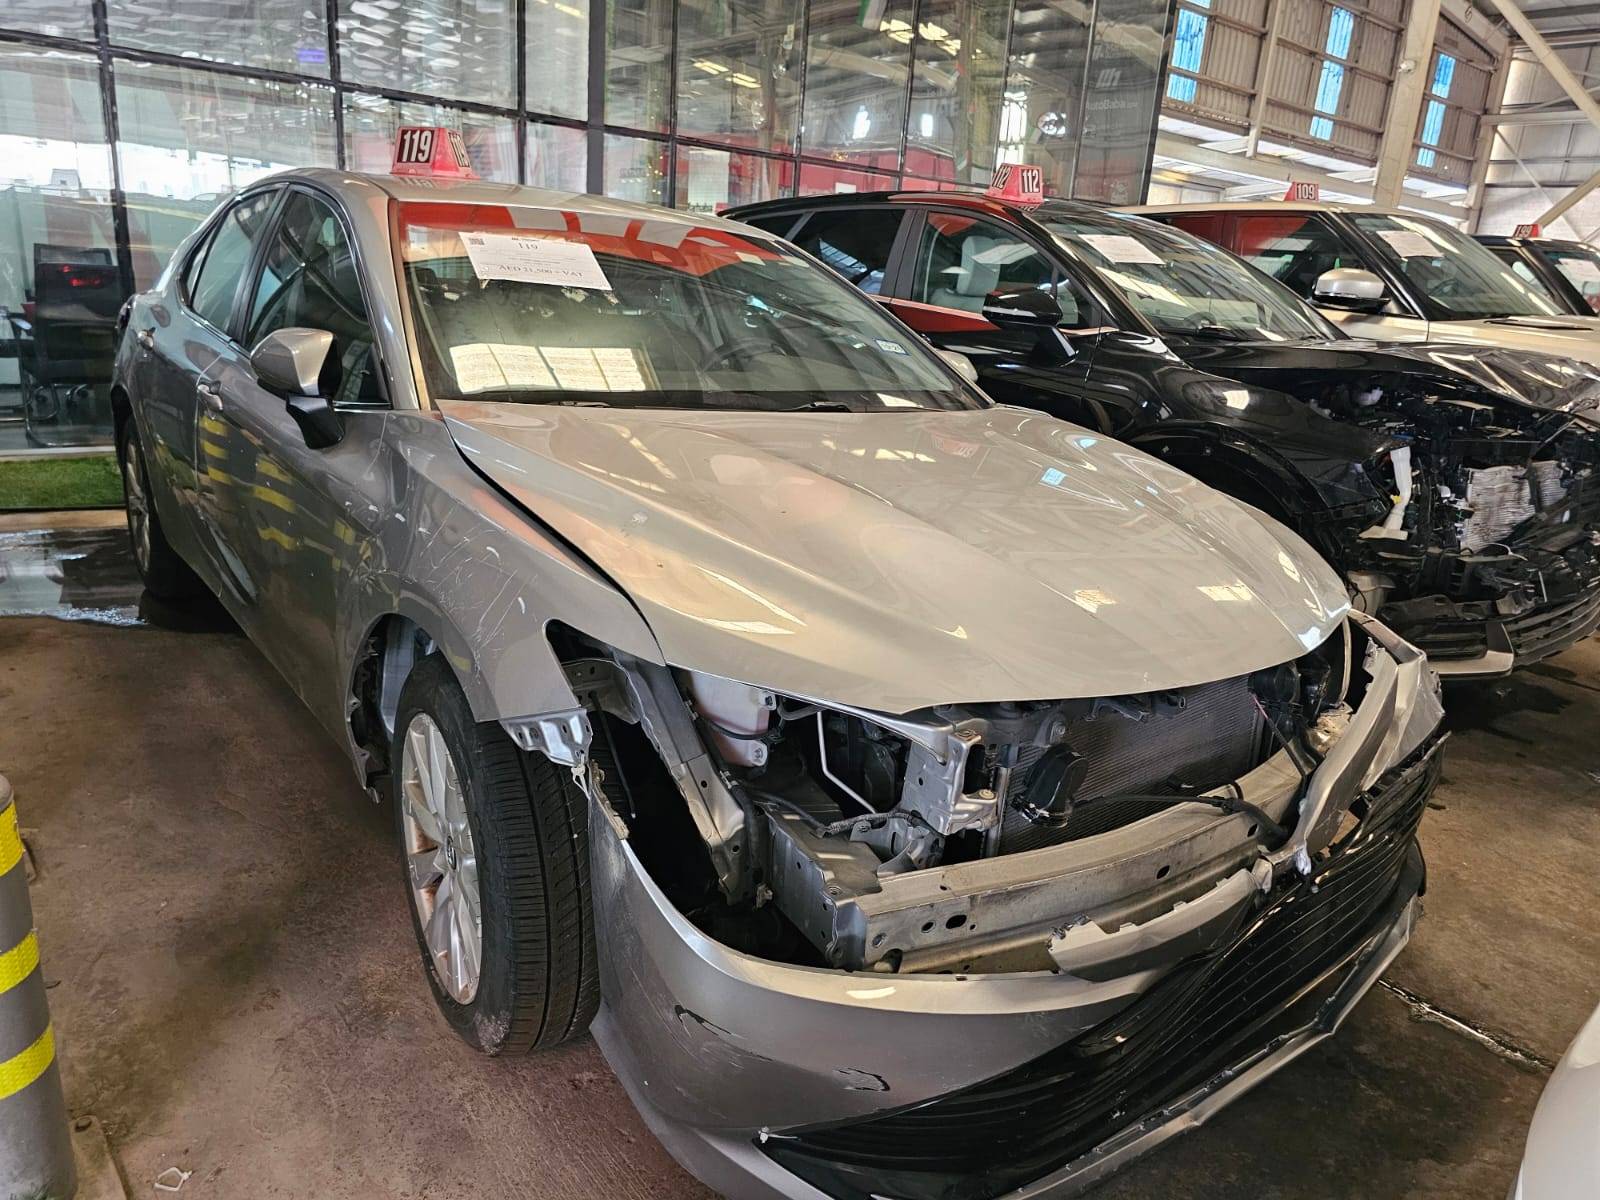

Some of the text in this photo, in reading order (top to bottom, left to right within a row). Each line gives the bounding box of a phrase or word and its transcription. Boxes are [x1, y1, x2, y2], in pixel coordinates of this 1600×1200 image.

[401, 130, 432, 162] 119
[1022, 169, 1040, 193] 112
[1298, 183, 1315, 199] 109
